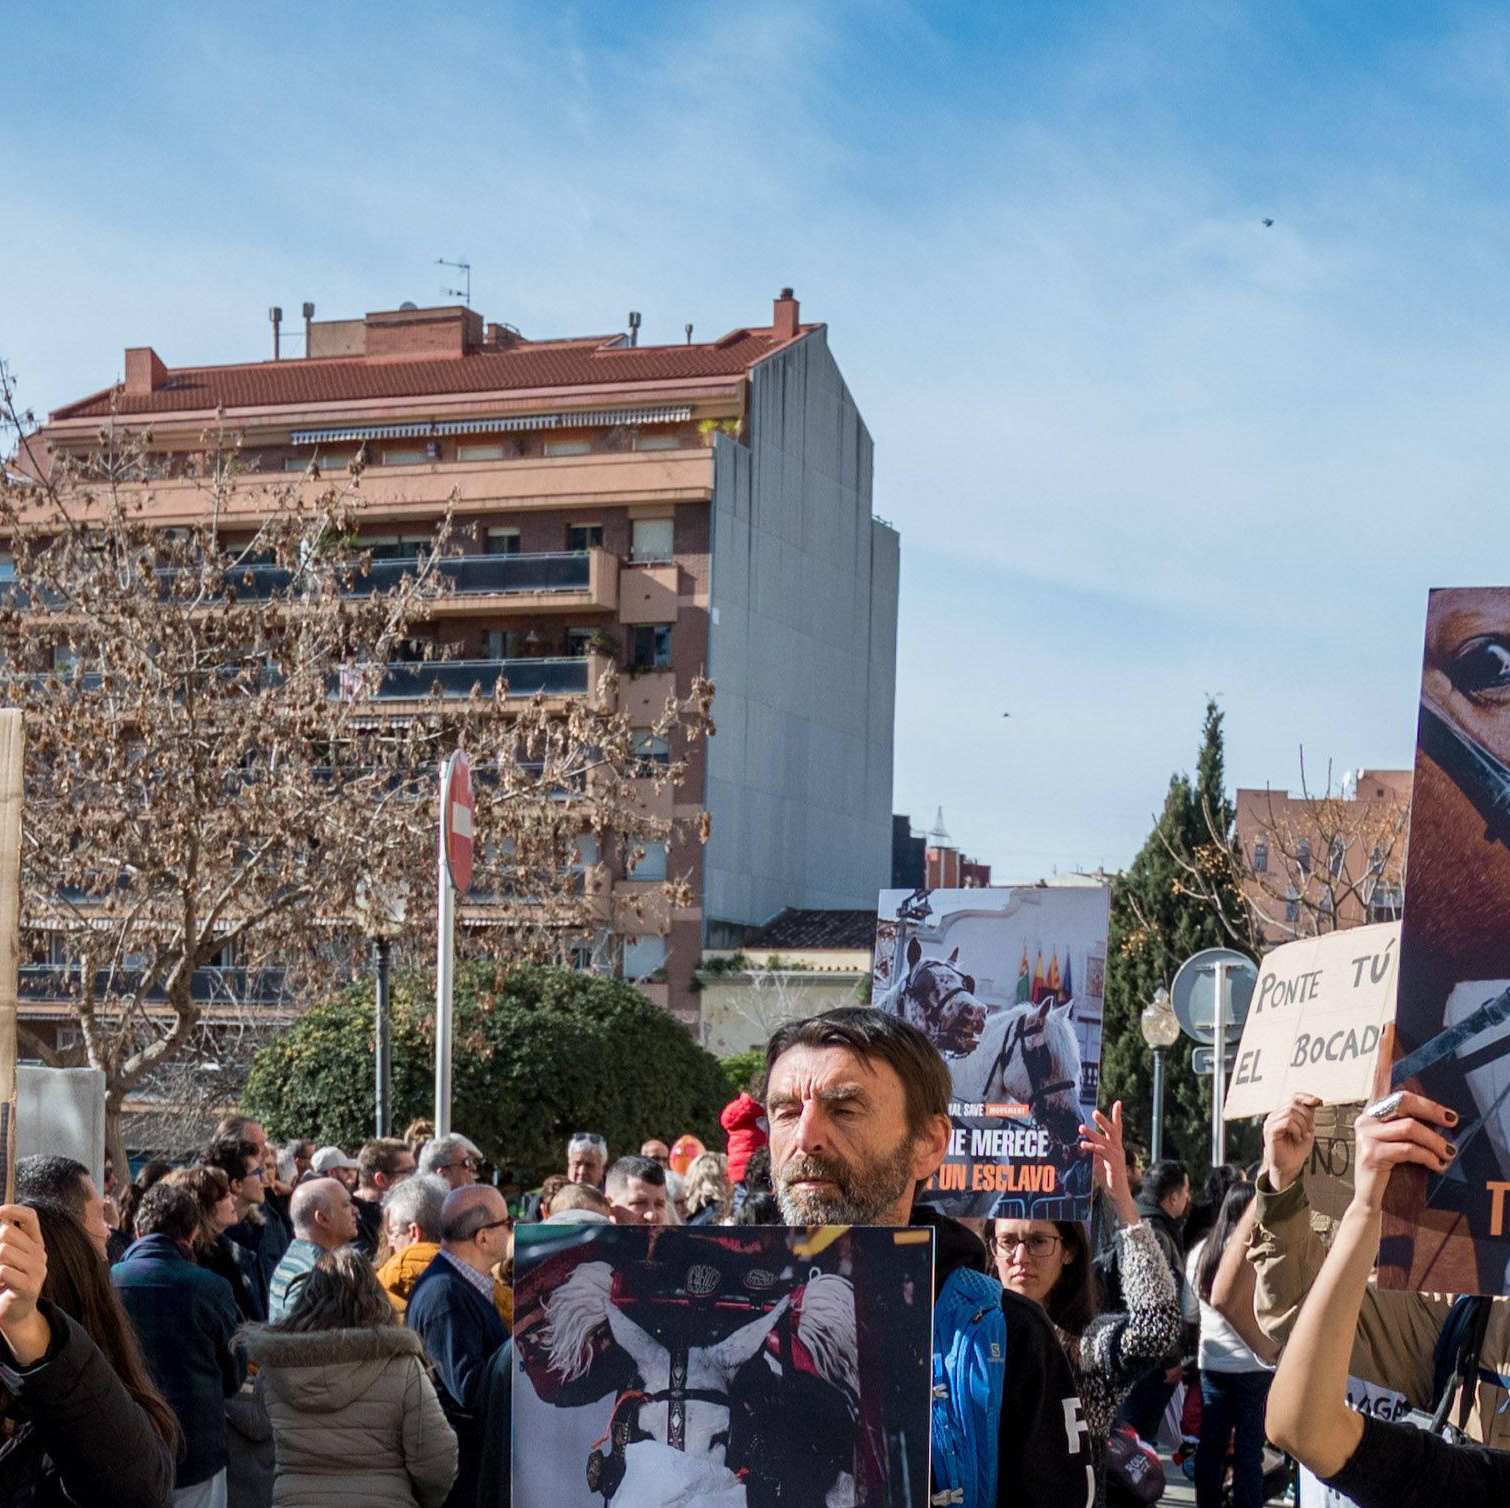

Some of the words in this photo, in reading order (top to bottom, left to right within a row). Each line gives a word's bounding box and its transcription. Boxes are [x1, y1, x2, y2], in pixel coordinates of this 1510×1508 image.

[1255, 970, 1323, 1014] PONTE
[1352, 938, 1396, 988] TÚ
[1236, 1049, 1262, 1085] EL
[963, 1103, 984, 1117] SAVE
[971, 1129, 1048, 1157] MERECE
[939, 1163, 967, 1190] UN
[972, 1164, 1055, 1192] ESCLAVO
